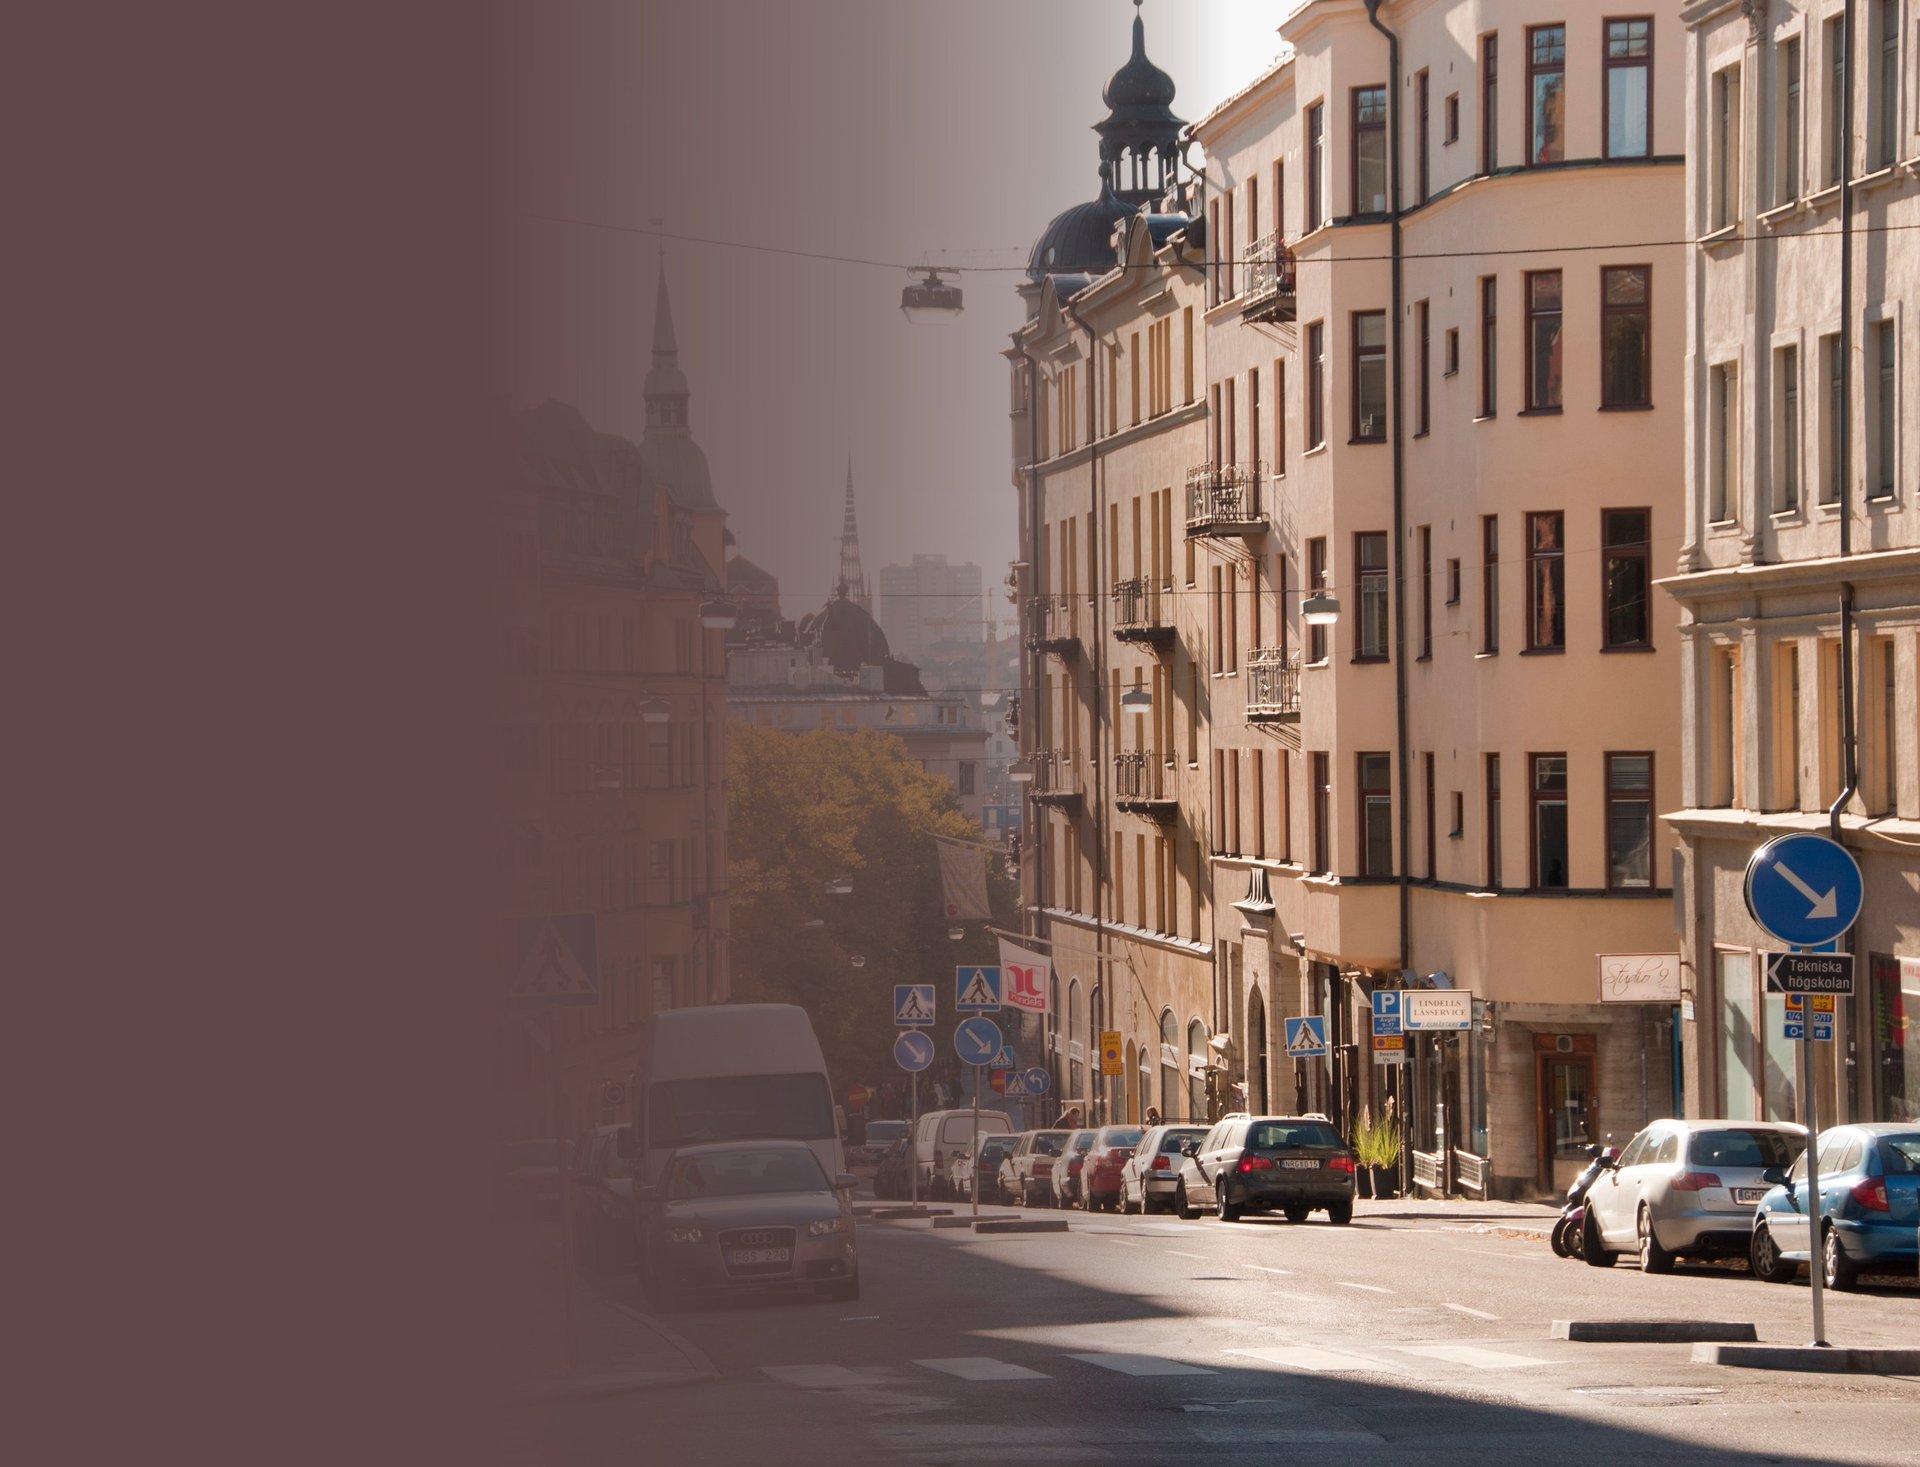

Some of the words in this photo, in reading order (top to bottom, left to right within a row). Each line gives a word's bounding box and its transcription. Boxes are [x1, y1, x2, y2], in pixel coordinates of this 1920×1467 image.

[1789, 959, 1842, 973] Tekniska
[1603, 957, 1664, 996] Studio
[1658, 968, 1669, 983] 9
[1788, 975, 1850, 990] högskolan
[1381, 992, 1396, 1014] P
[1816, 1029, 1826, 1037] m
